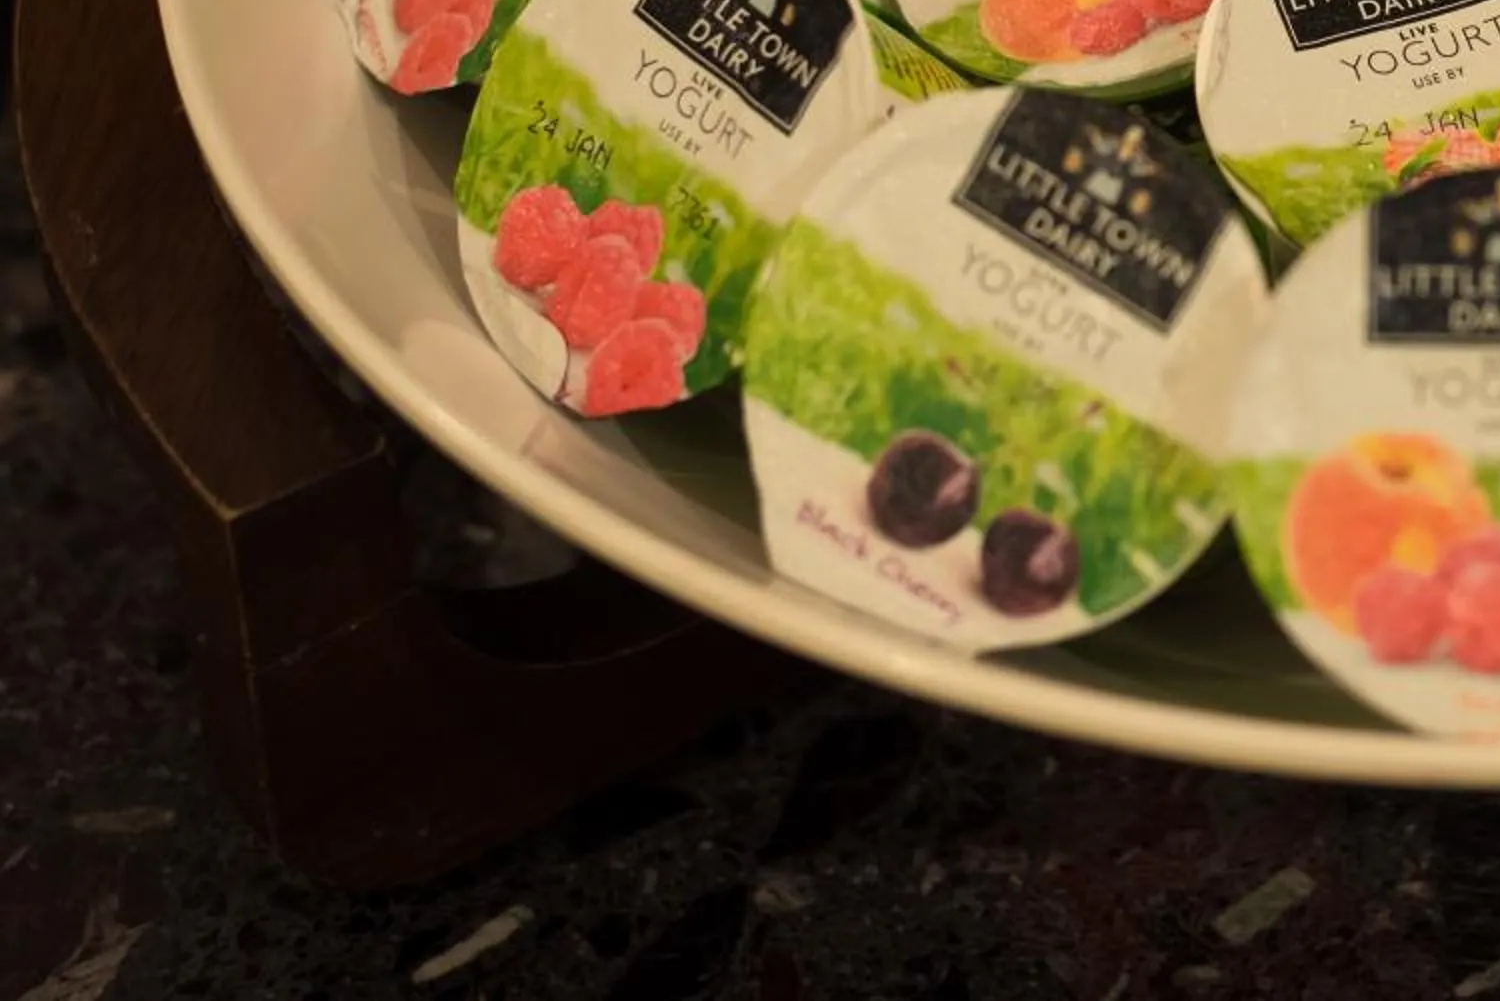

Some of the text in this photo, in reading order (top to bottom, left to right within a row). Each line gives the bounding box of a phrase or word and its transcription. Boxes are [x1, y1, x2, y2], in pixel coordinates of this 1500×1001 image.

[687, 18, 766, 80] DAIRY
[753, 19, 819, 88] TOWN
[1398, 22, 1439, 42] LIVE
[626, 49, 755, 160] YOGURT
[691, 70, 726, 101] LIVE
[1412, 66, 1465, 90] USE BY
[526, 100, 614, 171] 24 JAN
[1348, 106, 1480, 148] 24 JAN
[985, 143, 1197, 289] LITTLE TOWN
[1024, 208, 1120, 280] DAIRY
[958, 242, 1125, 363] YOGURT
